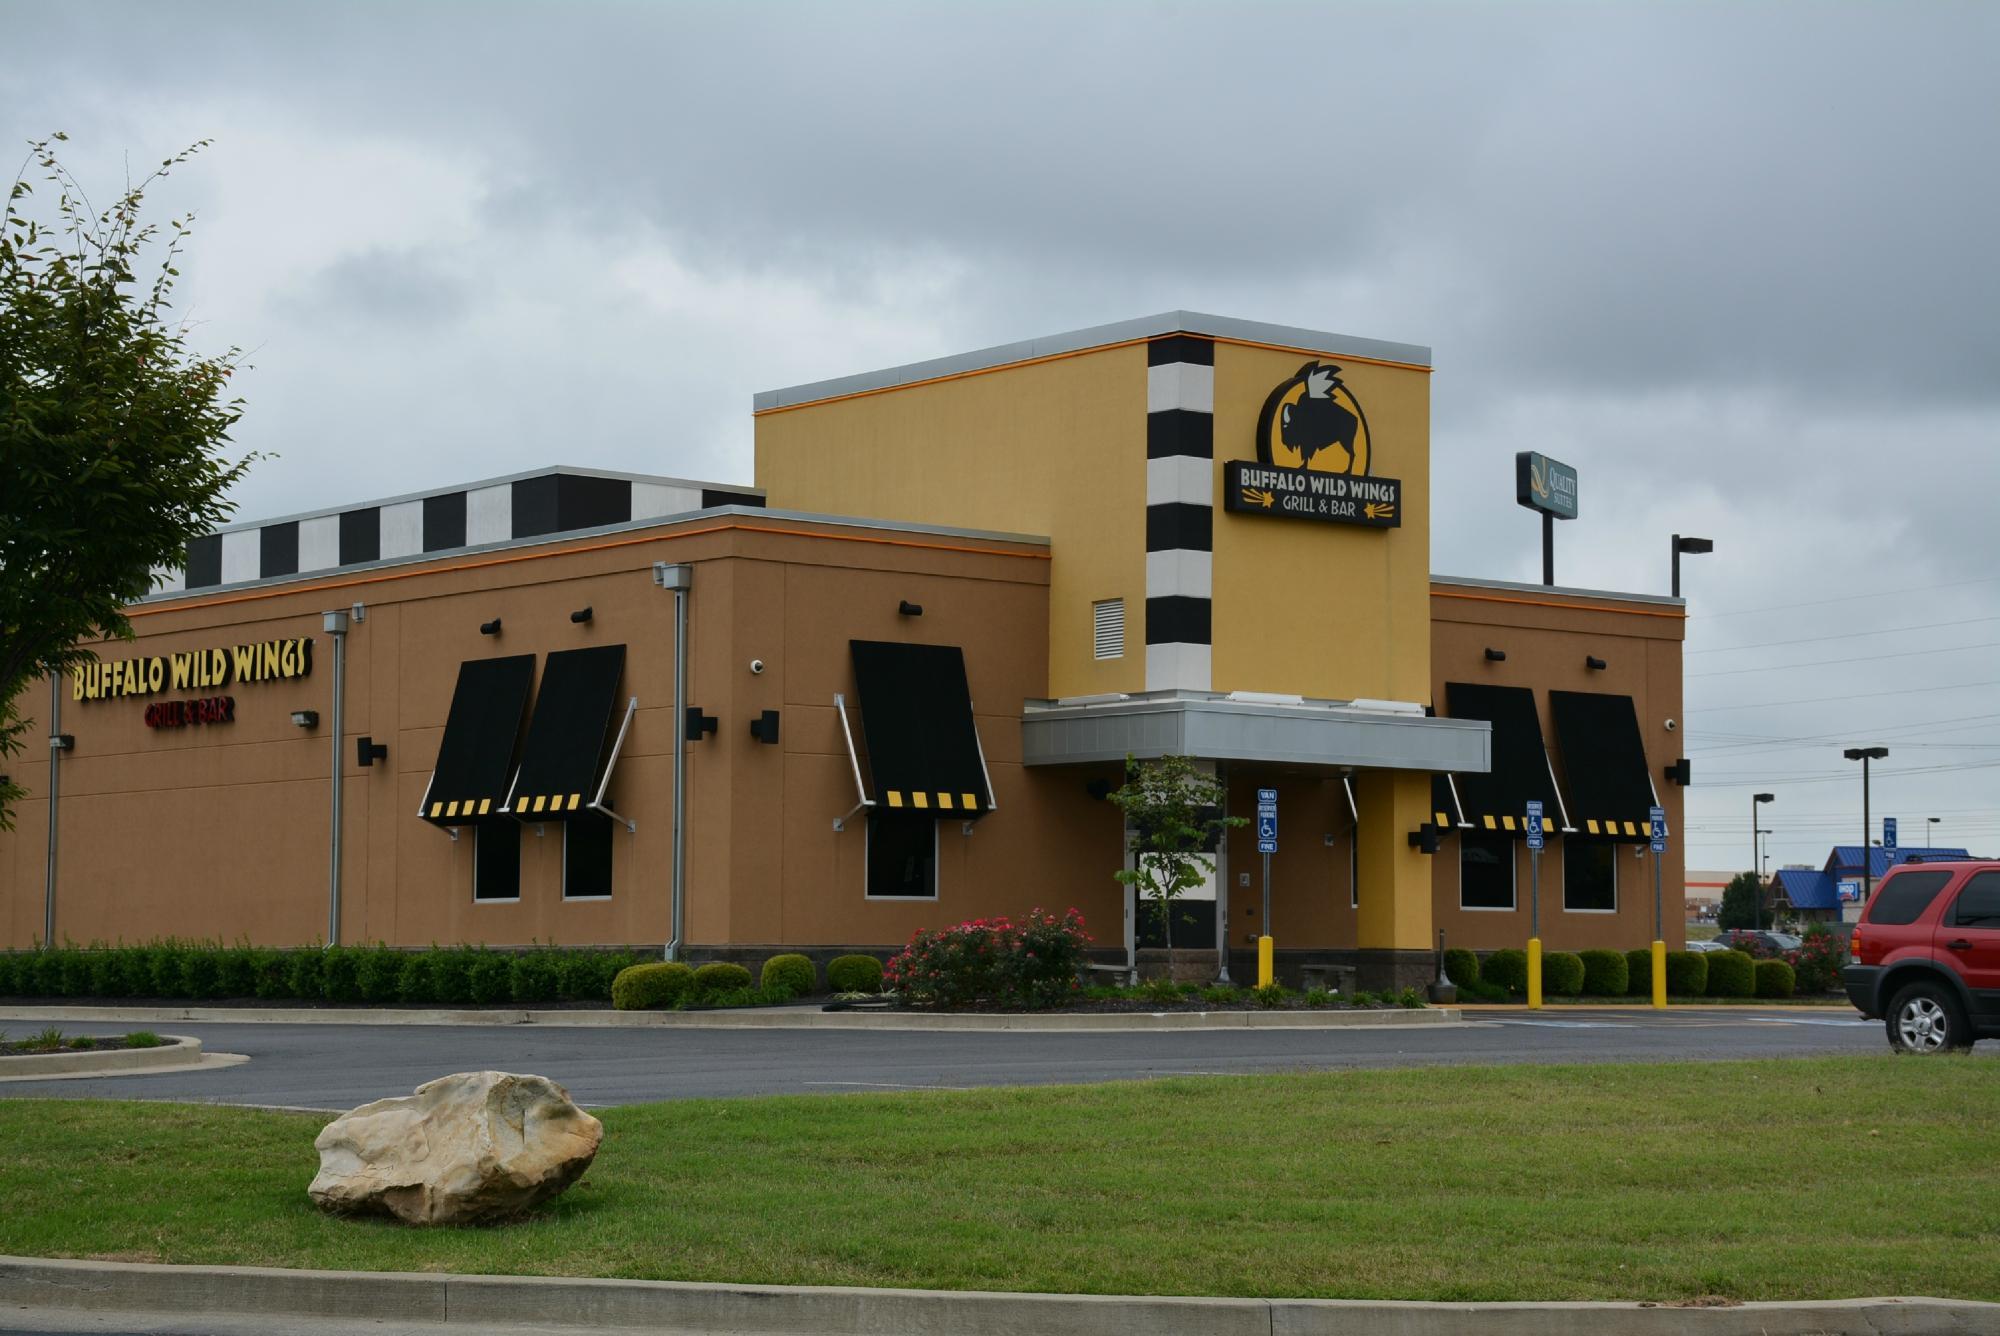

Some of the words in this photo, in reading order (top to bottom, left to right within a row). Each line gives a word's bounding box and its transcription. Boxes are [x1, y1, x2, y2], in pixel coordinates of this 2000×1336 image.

[1240, 468, 1306, 492] BUFFALO
[1309, 476, 1347, 497] WILD
[1350, 480, 1395, 503] WINGS
[1282, 495, 1315, 513] GRILL
[1318, 498, 1329, 513] &
[1331, 500, 1357, 517] BAR
[73, 656, 164, 701] BUFFALO
[170, 648, 228, 690] WILD
[233, 637, 306, 682] WINGS
[199, 696, 230, 723] BAR
[1260, 791, 1275, 799] VAN
